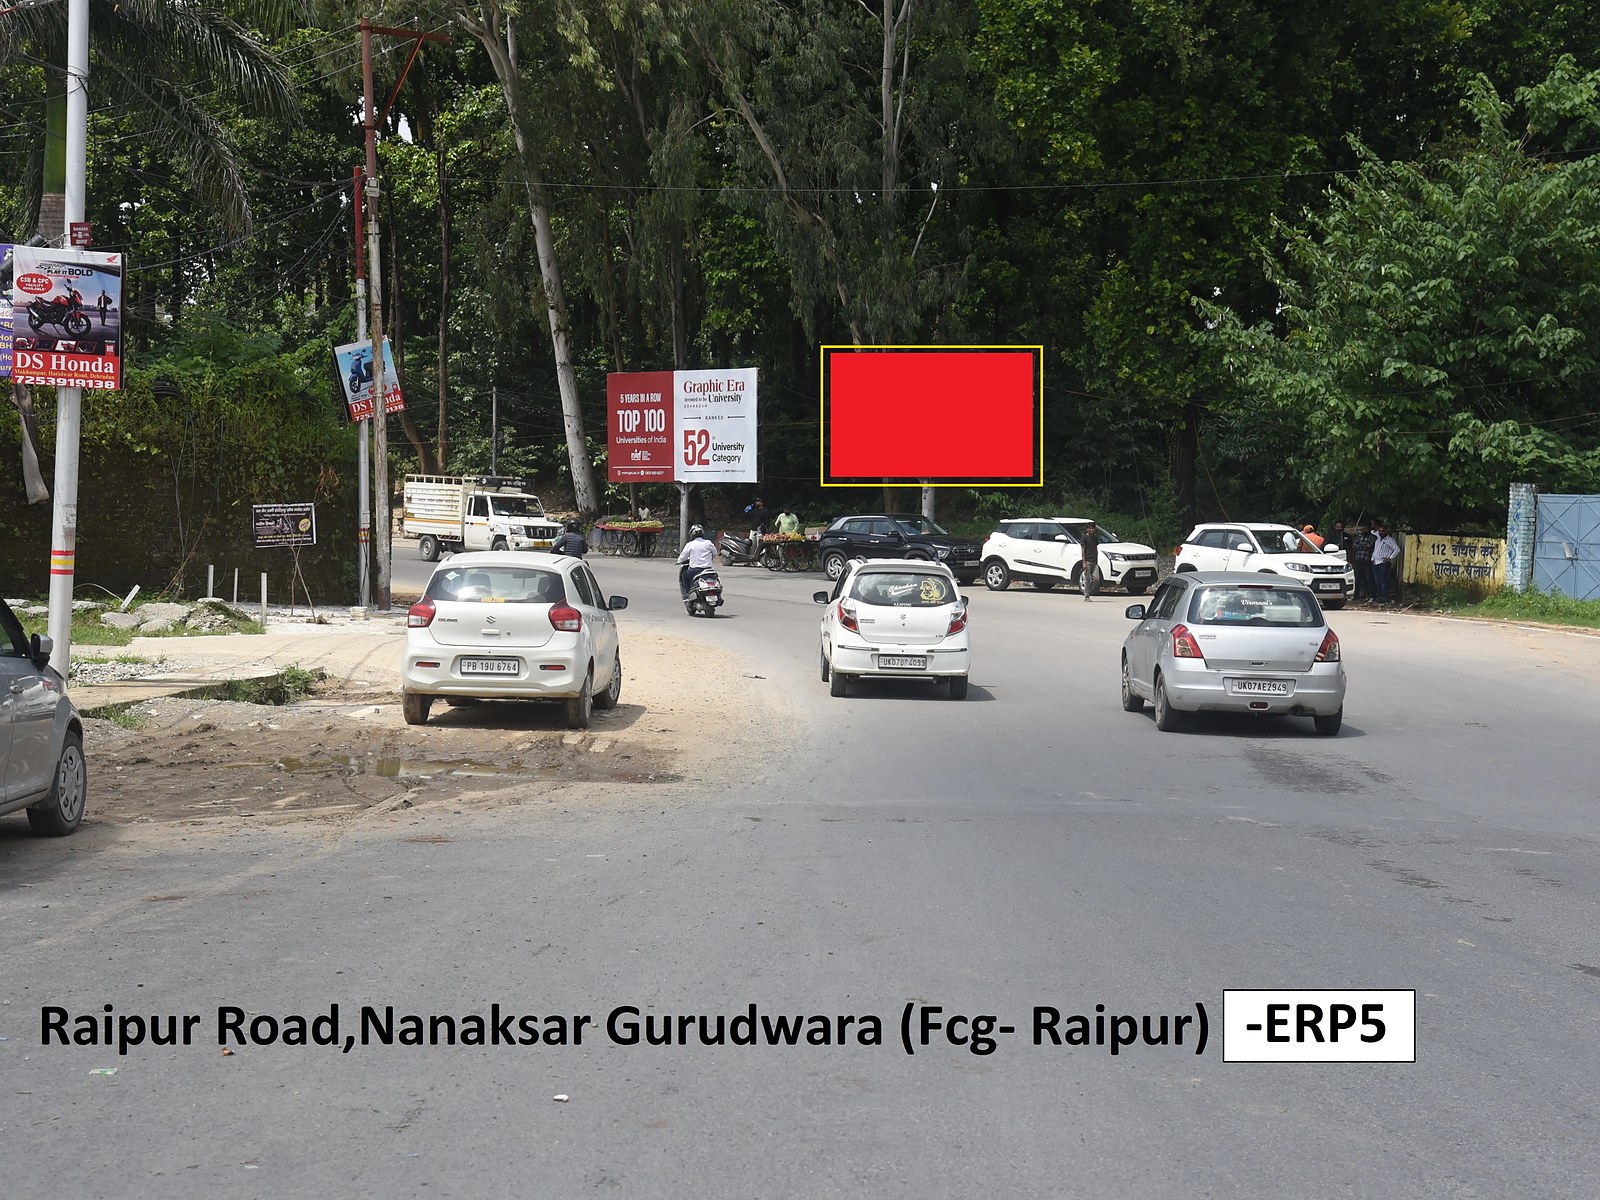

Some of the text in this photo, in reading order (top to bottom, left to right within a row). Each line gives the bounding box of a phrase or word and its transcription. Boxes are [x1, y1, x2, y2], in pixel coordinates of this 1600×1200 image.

[68, 268, 93, 277] BOLD
[15, 352, 115, 374] DS Honda
[15, 375, 116, 389] 7253919138
[683, 379, 745, 396] Graphic Era
[620, 394, 625, 403] 5
[624, 393, 640, 403] YEARS
[646, 393, 650, 403] A
[650, 392, 662, 403] ROW
[708, 393, 743, 404] University
[352, 401, 367, 413] DS
[617, 408, 666, 433] TOP 100
[616, 435, 667, 444] Universities of India
[683, 428, 710, 466] 52
[712, 442, 745, 453] University
[712, 453, 742, 464] Category
[1431, 543, 1447, 556] 112
[1240, 598, 1273, 606] Virmani's
[466, 661, 517, 672] PB 19U 6764
[1237, 681, 1287, 692] UK07AE2949
